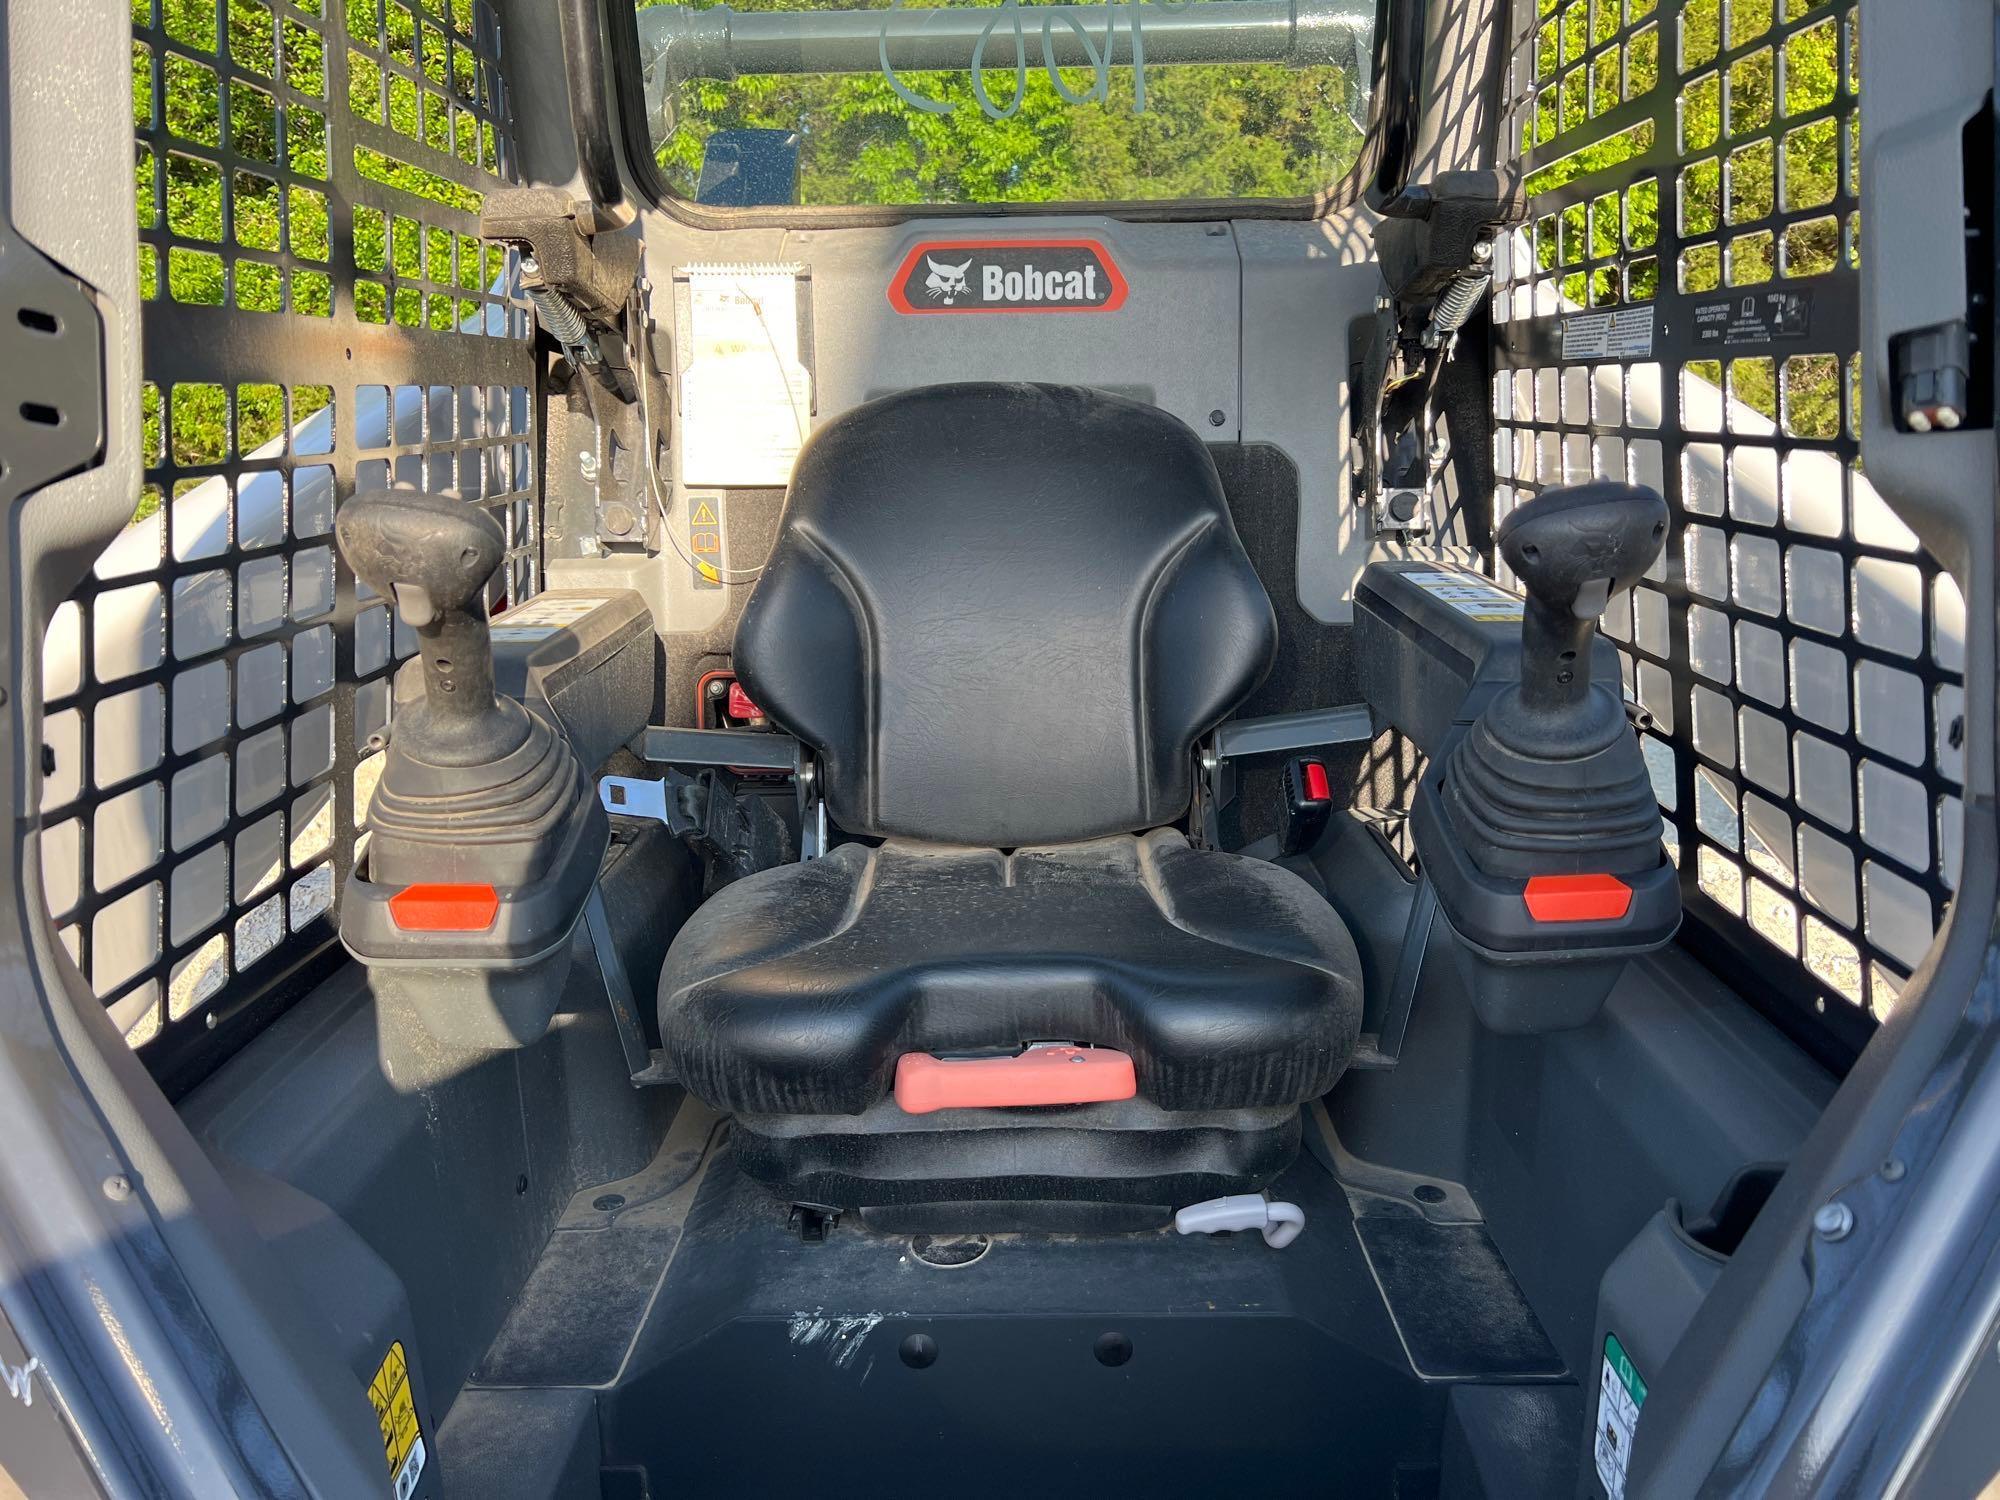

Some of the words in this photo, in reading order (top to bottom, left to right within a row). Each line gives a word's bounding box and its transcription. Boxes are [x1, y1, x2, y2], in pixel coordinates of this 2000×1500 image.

[982, 264, 1096, 301] Bobcat
[1708, 304, 1730, 313] OPERATING
[1697, 314, 1715, 323] CAPACITY
